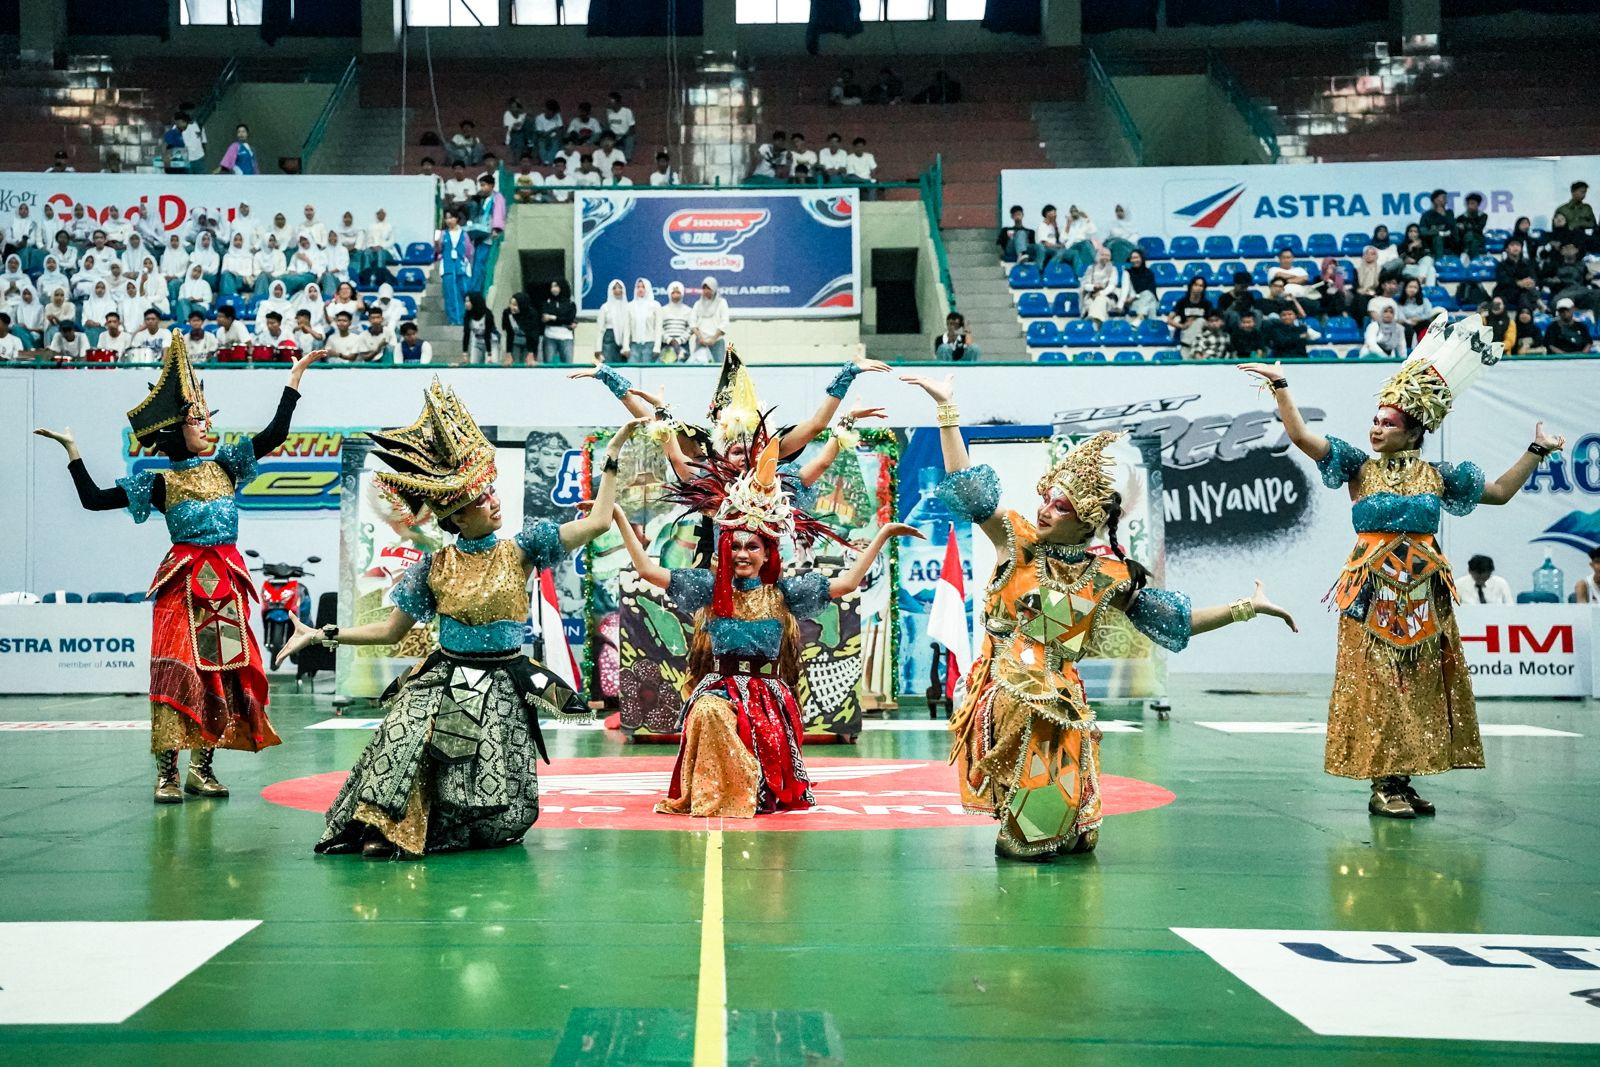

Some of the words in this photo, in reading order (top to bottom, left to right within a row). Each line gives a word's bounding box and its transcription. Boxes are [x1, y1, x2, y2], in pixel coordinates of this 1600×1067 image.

[1254, 193, 1370, 218] ASTRA
[693, 219, 744, 227] HONDA
[719, 285, 790, 295] REAMERS
[1053, 394, 1201, 424] BEAT
[908, 560, 973, 581] AQA
[60, 638, 135, 653] MOTOR
[95, 660, 103, 668] of
[105, 660, 135, 668] ASTRA
[1468, 661, 1513, 676] onda
[1519, 661, 1574, 676] Motor
